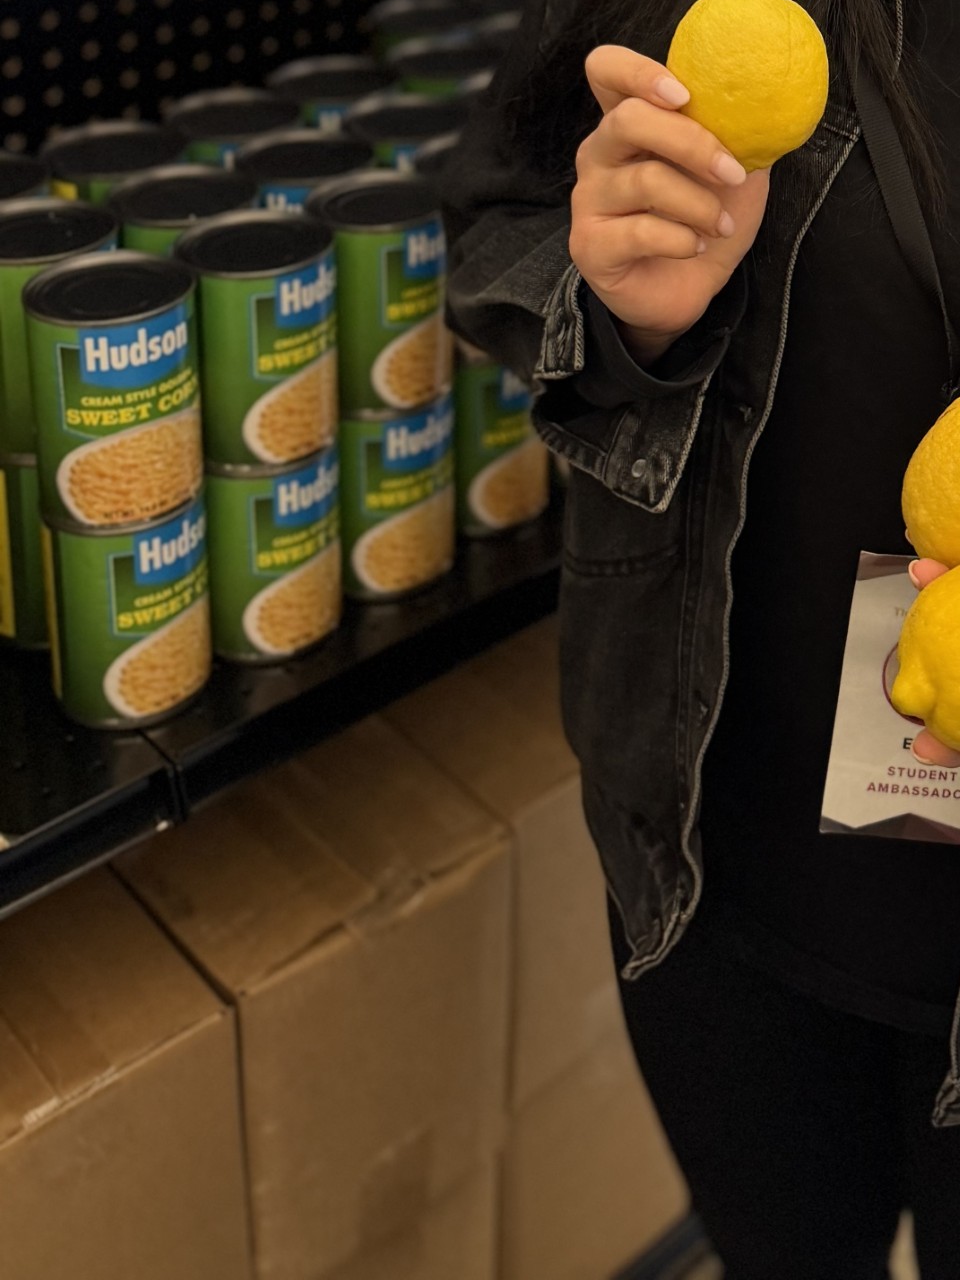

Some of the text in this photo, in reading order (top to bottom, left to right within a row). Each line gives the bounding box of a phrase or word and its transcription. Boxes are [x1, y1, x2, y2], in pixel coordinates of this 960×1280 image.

[84, 321, 188, 373] Hudson
[81, 394, 123, 407] CREAM
[125, 386, 157, 404] STYLE
[66, 401, 153, 427] SWEET
[116, 586, 193, 629] SWEET
[887, 765, 958, 783] STUDENT
